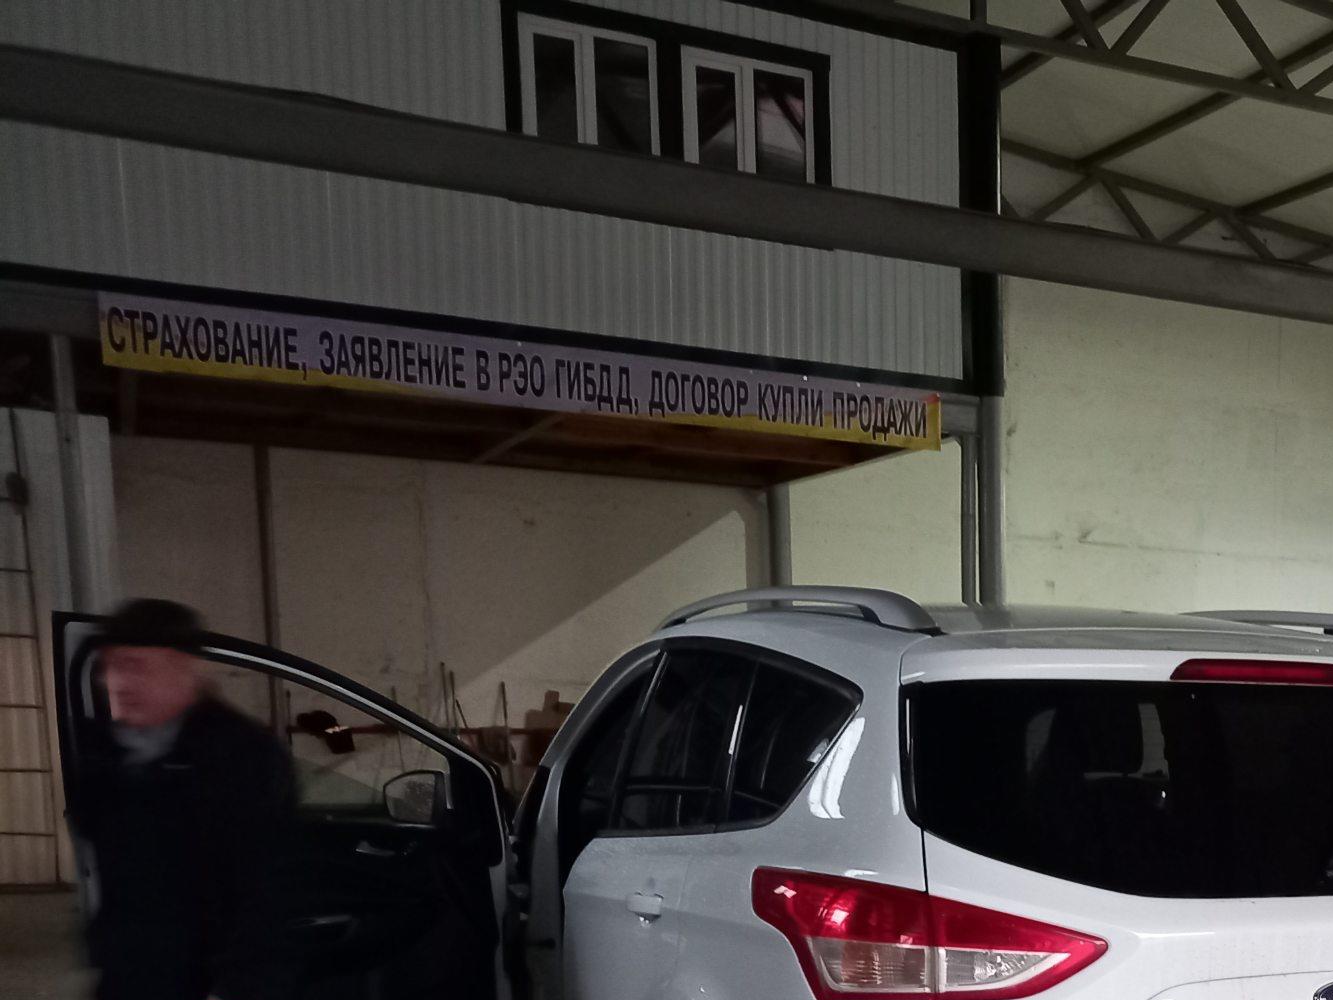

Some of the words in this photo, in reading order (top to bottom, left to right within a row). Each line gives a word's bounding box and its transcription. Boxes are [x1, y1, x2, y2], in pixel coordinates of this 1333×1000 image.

[106, 305, 306, 380] СТРАХОВАНИЕ,
[318, 330, 466, 389] ЗАЯВЛЕНИЕ
[475, 350, 491, 391] В
[498, 352, 546, 397] РЭО
[555, 358, 639, 415] ГИБДД,
[648, 370, 749, 418] ДОГОВОР
[757, 382, 824, 428] КУПЛИ
[833, 391, 927, 441] ПРОДАЖИ
